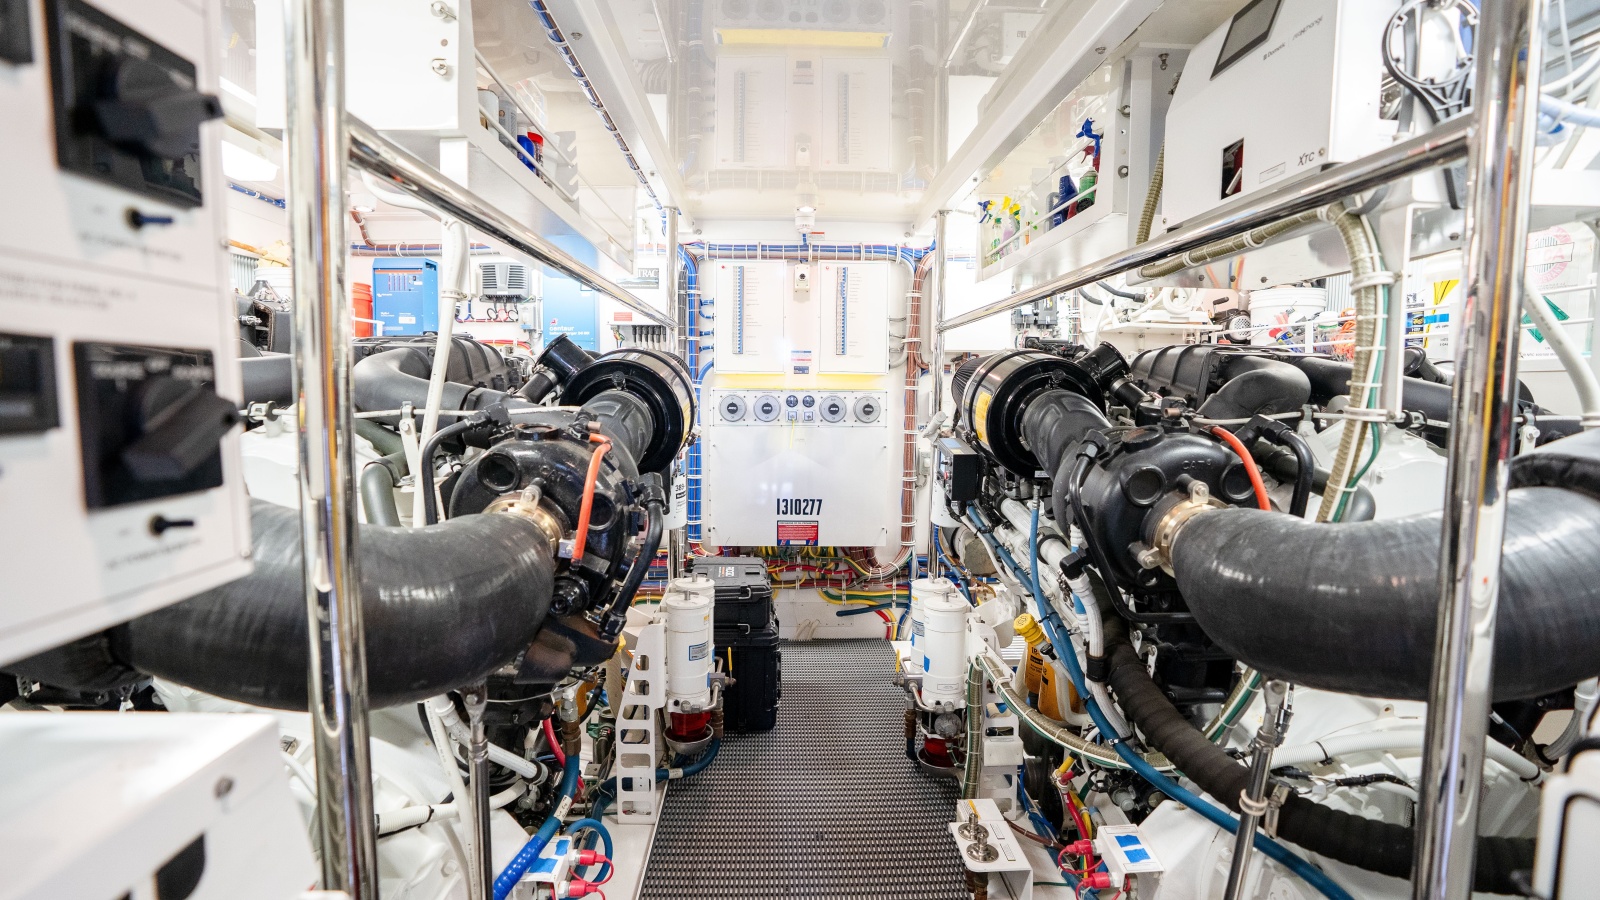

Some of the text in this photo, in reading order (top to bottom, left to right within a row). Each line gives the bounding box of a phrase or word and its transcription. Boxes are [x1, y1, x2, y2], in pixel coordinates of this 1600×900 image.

[1297, 151, 1315, 167] XTC
[1182, 460, 1205, 470] CAT
[776, 498, 823, 515] 1310277
